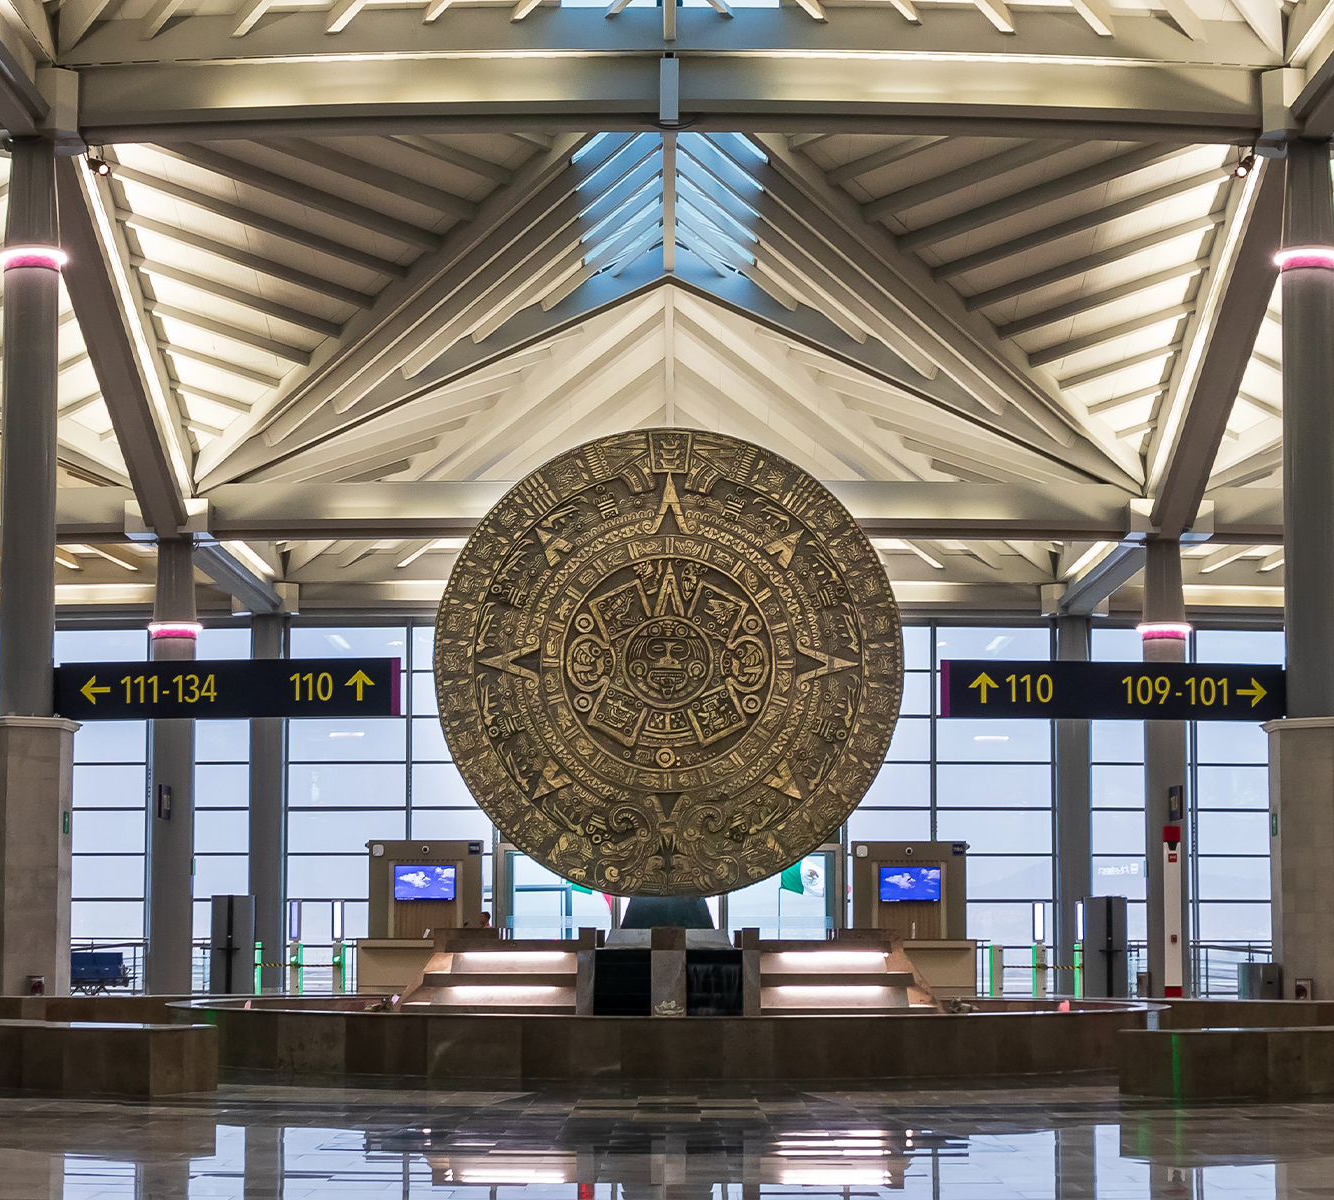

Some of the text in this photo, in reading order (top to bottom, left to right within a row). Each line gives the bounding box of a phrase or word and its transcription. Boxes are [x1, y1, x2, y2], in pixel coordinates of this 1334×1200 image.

[120, 674, 217, 704] 111-134
[289, 672, 333, 701] 110
[1005, 674, 1053, 703] 110
[1122, 676, 1228, 706] 109-101
